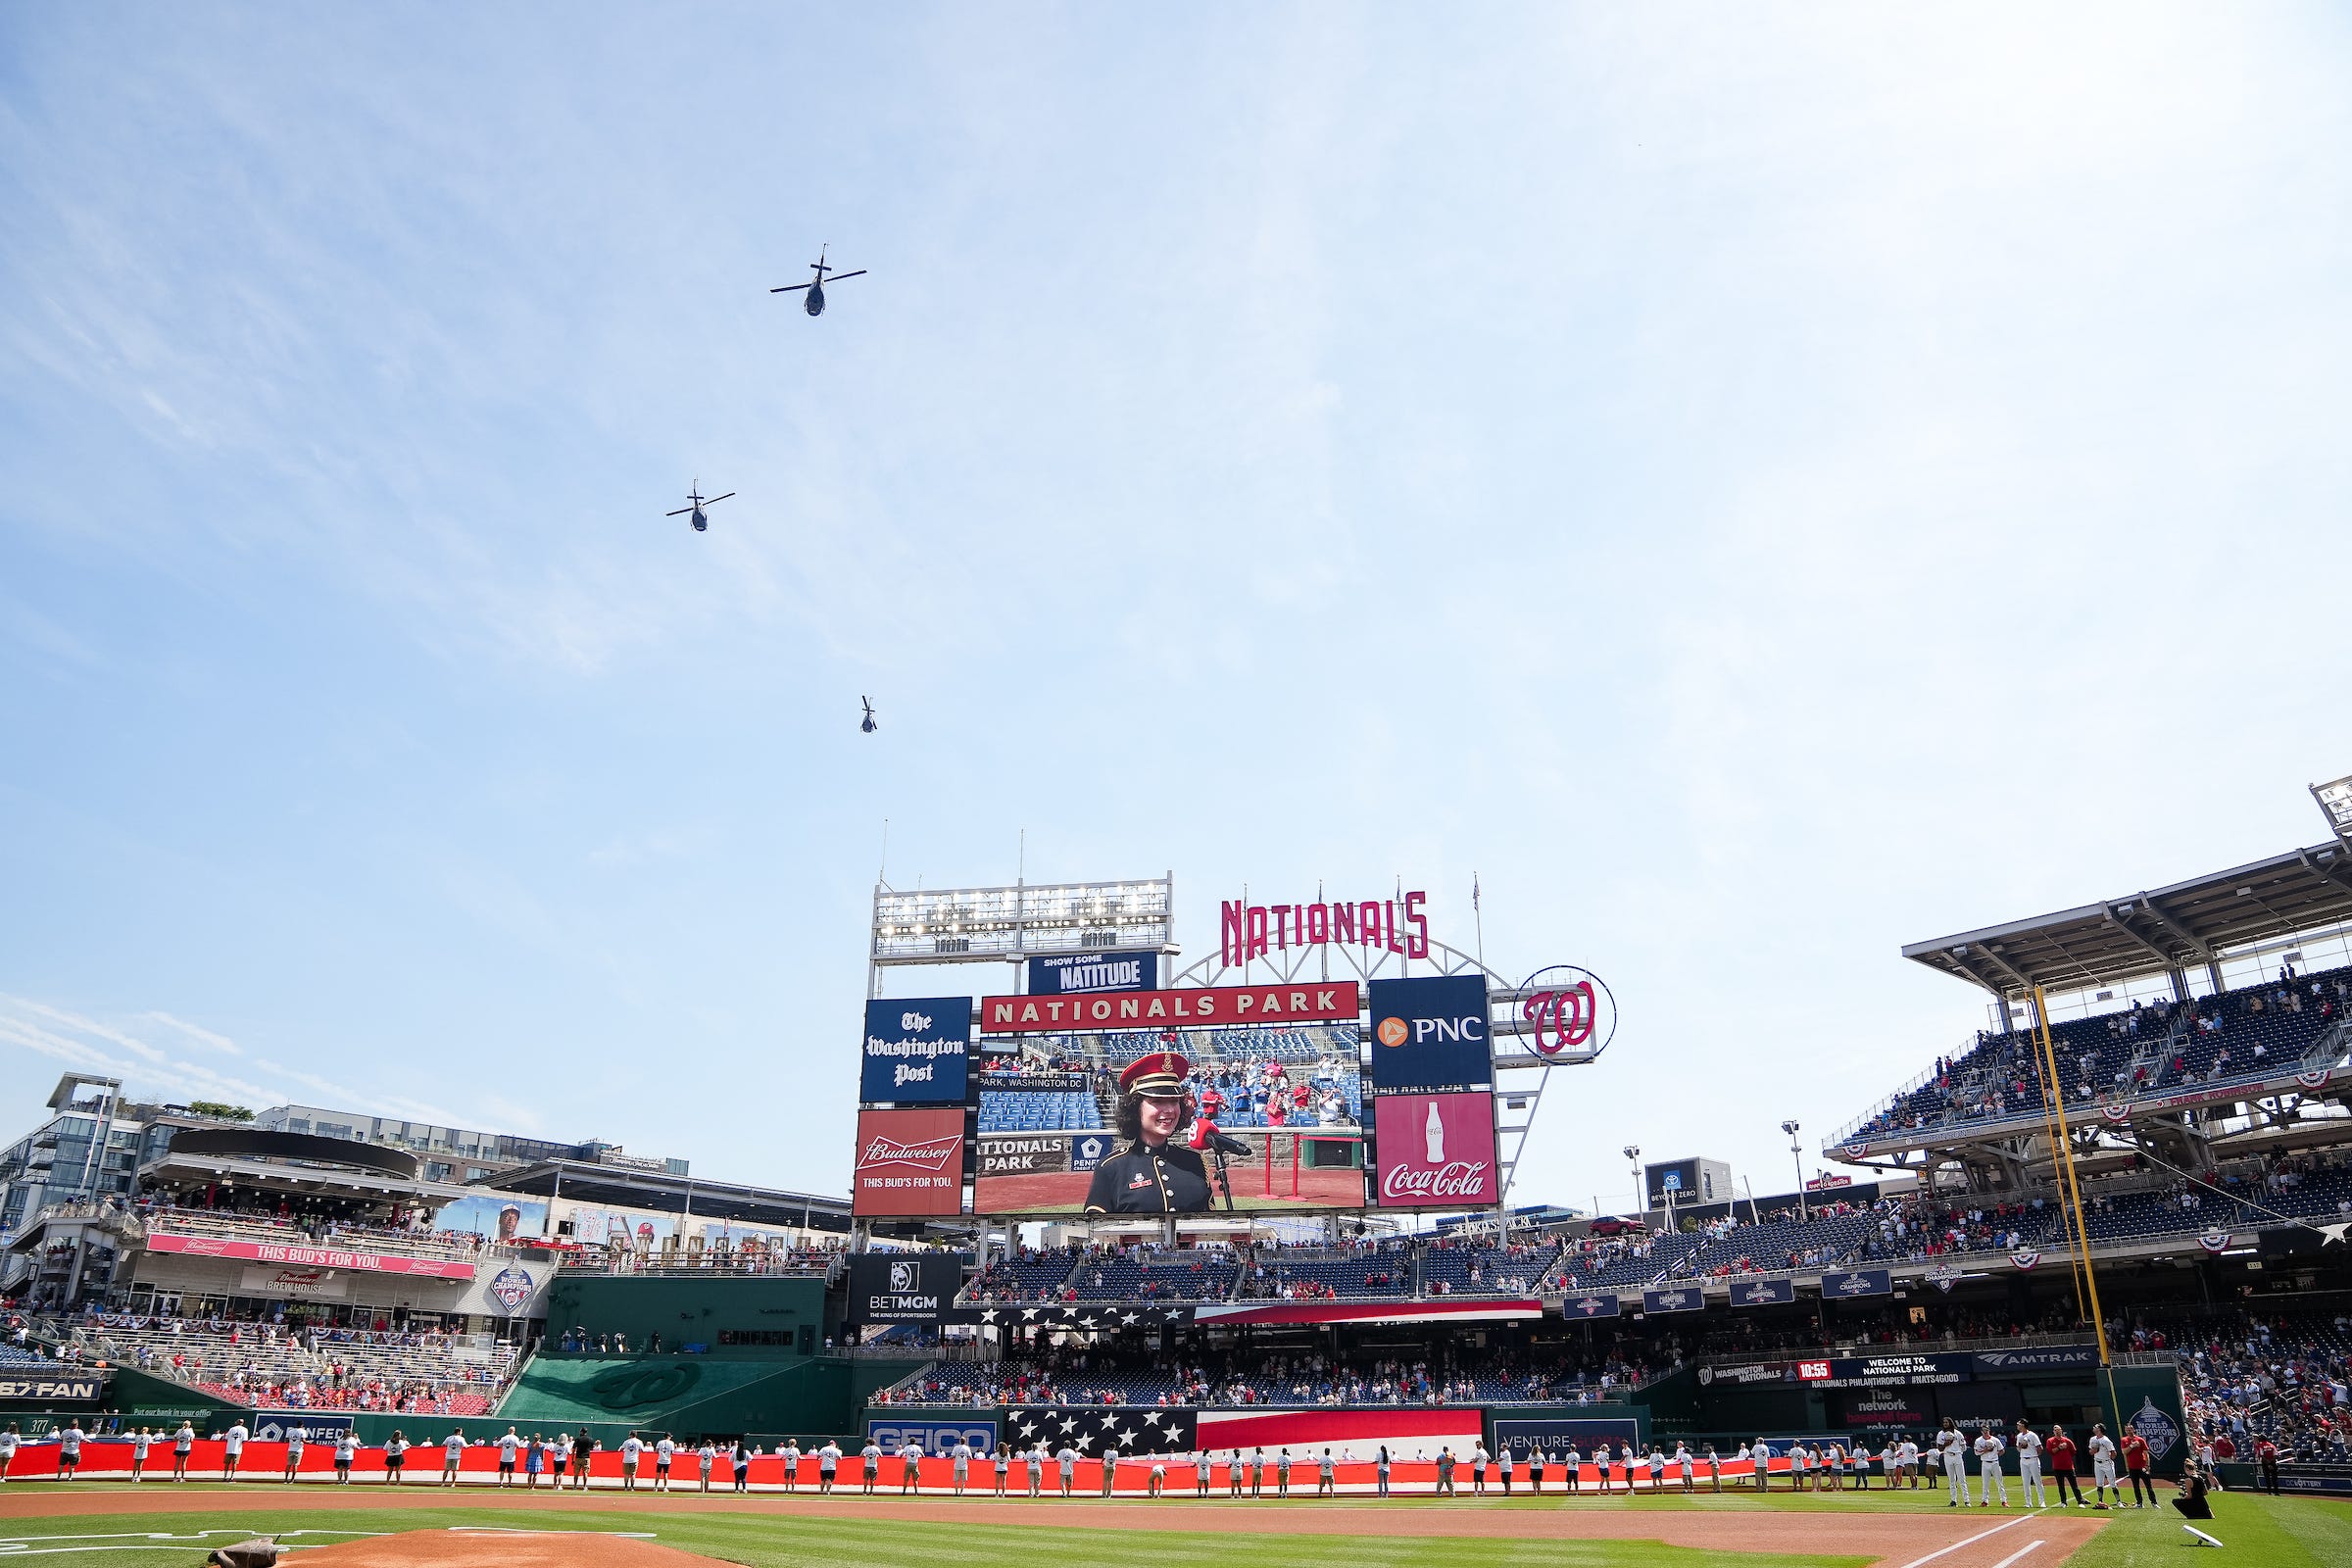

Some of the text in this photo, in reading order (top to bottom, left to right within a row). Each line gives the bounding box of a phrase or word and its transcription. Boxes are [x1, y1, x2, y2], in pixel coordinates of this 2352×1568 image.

[1222, 891, 1428, 967] NATIONALS
[1044, 955, 1102, 966] SHOW SOME
[1060, 960, 1141, 989] NATITUDE
[995, 990, 1337, 1022] NATIONALS PARK
[902, 1012, 932, 1032] The
[1412, 1016, 1483, 1043] PNC
[866, 1035, 964, 1059] Washington
[894, 1063, 933, 1087] Post
[1008, 1079, 1067, 1088] WASHINGTON
[866, 1143, 951, 1160] Budweiser
[985, 1155, 1034, 1170] PARK
[863, 1177, 953, 1188] THIS BUD'S FOR YOU.
[1384, 1161, 1489, 1198] Coca-Cola
[1678, 1190, 1696, 1199] ZERO
[258, 1246, 382, 1269] THIS BUD'S FOR YOU.
[1925, 1273, 1963, 1282] CHAMPIONS
[267, 1281, 323, 1294] BREW HOUSE
[493, 1283, 532, 1293] CHAMPIONS
[1839, 1281, 1871, 1291] CHAMPIONS
[870, 1296, 938, 1309] BETMGM
[1869, 1358, 1912, 1367] WELCOME
[2007, 1352, 2088, 1364] AMTRAK
[1715, 1365, 1765, 1379] WASHINGTON
[1799, 1362, 1828, 1378] 10:55
[1863, 1364, 1936, 1375] NATIONALS PARK
[1739, 1370, 1782, 1383] NATIONALS
[1811, 1373, 1959, 1389] NATIONALS PHILANTHROPIES #NATS4GOOD
[36, 1383, 94, 1397] FAN
[1869, 1389, 1892, 1400] The
[1858, 1399, 1907, 1411] network
[1846, 1410, 1922, 1422] baseball fans
[1955, 1417, 2003, 1428] verizon
[30, 1419, 48, 1433] 377
[2135, 1428, 2177, 1437] HAMPIONS
[285, 1427, 346, 1440] PNFED
[873, 1428, 992, 1453] GEICO
[1503, 1435, 1627, 1447] VENTURE GLOBA
